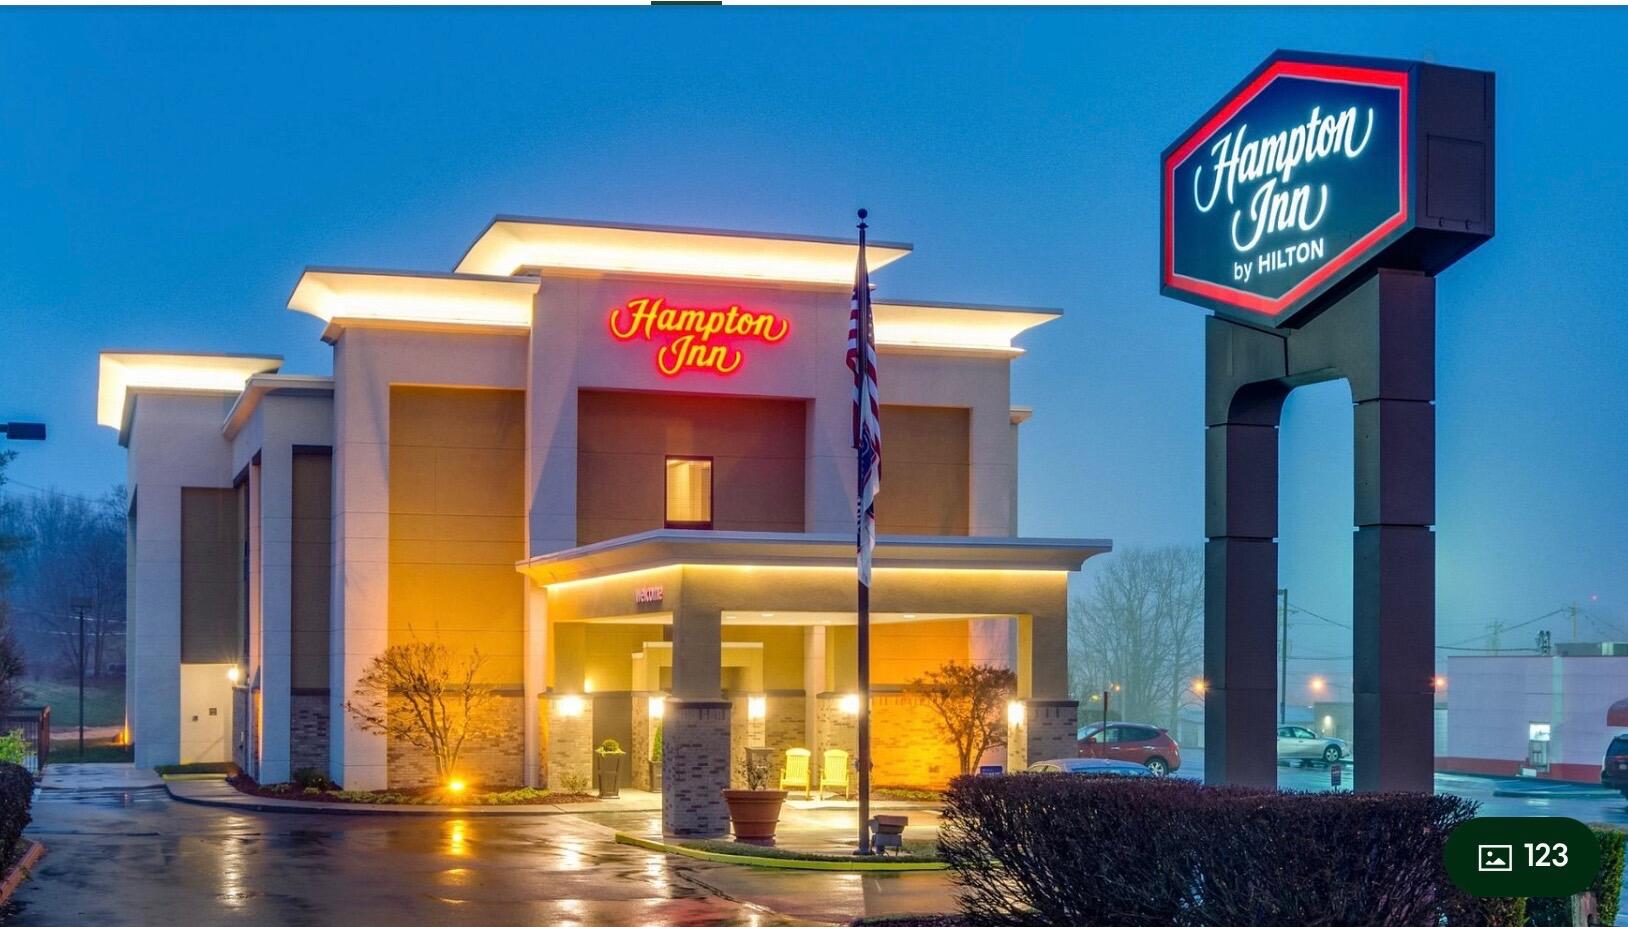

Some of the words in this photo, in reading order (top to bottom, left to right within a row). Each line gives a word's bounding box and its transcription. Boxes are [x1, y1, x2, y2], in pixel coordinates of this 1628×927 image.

[1194, 106, 1374, 212] Hampton
[1231, 177, 1328, 252] Inn
[1234, 261, 1253, 283] by
[1258, 237, 1324, 275] HILTON
[609, 297, 789, 342] Hampton
[657, 334, 742, 376] Inn
